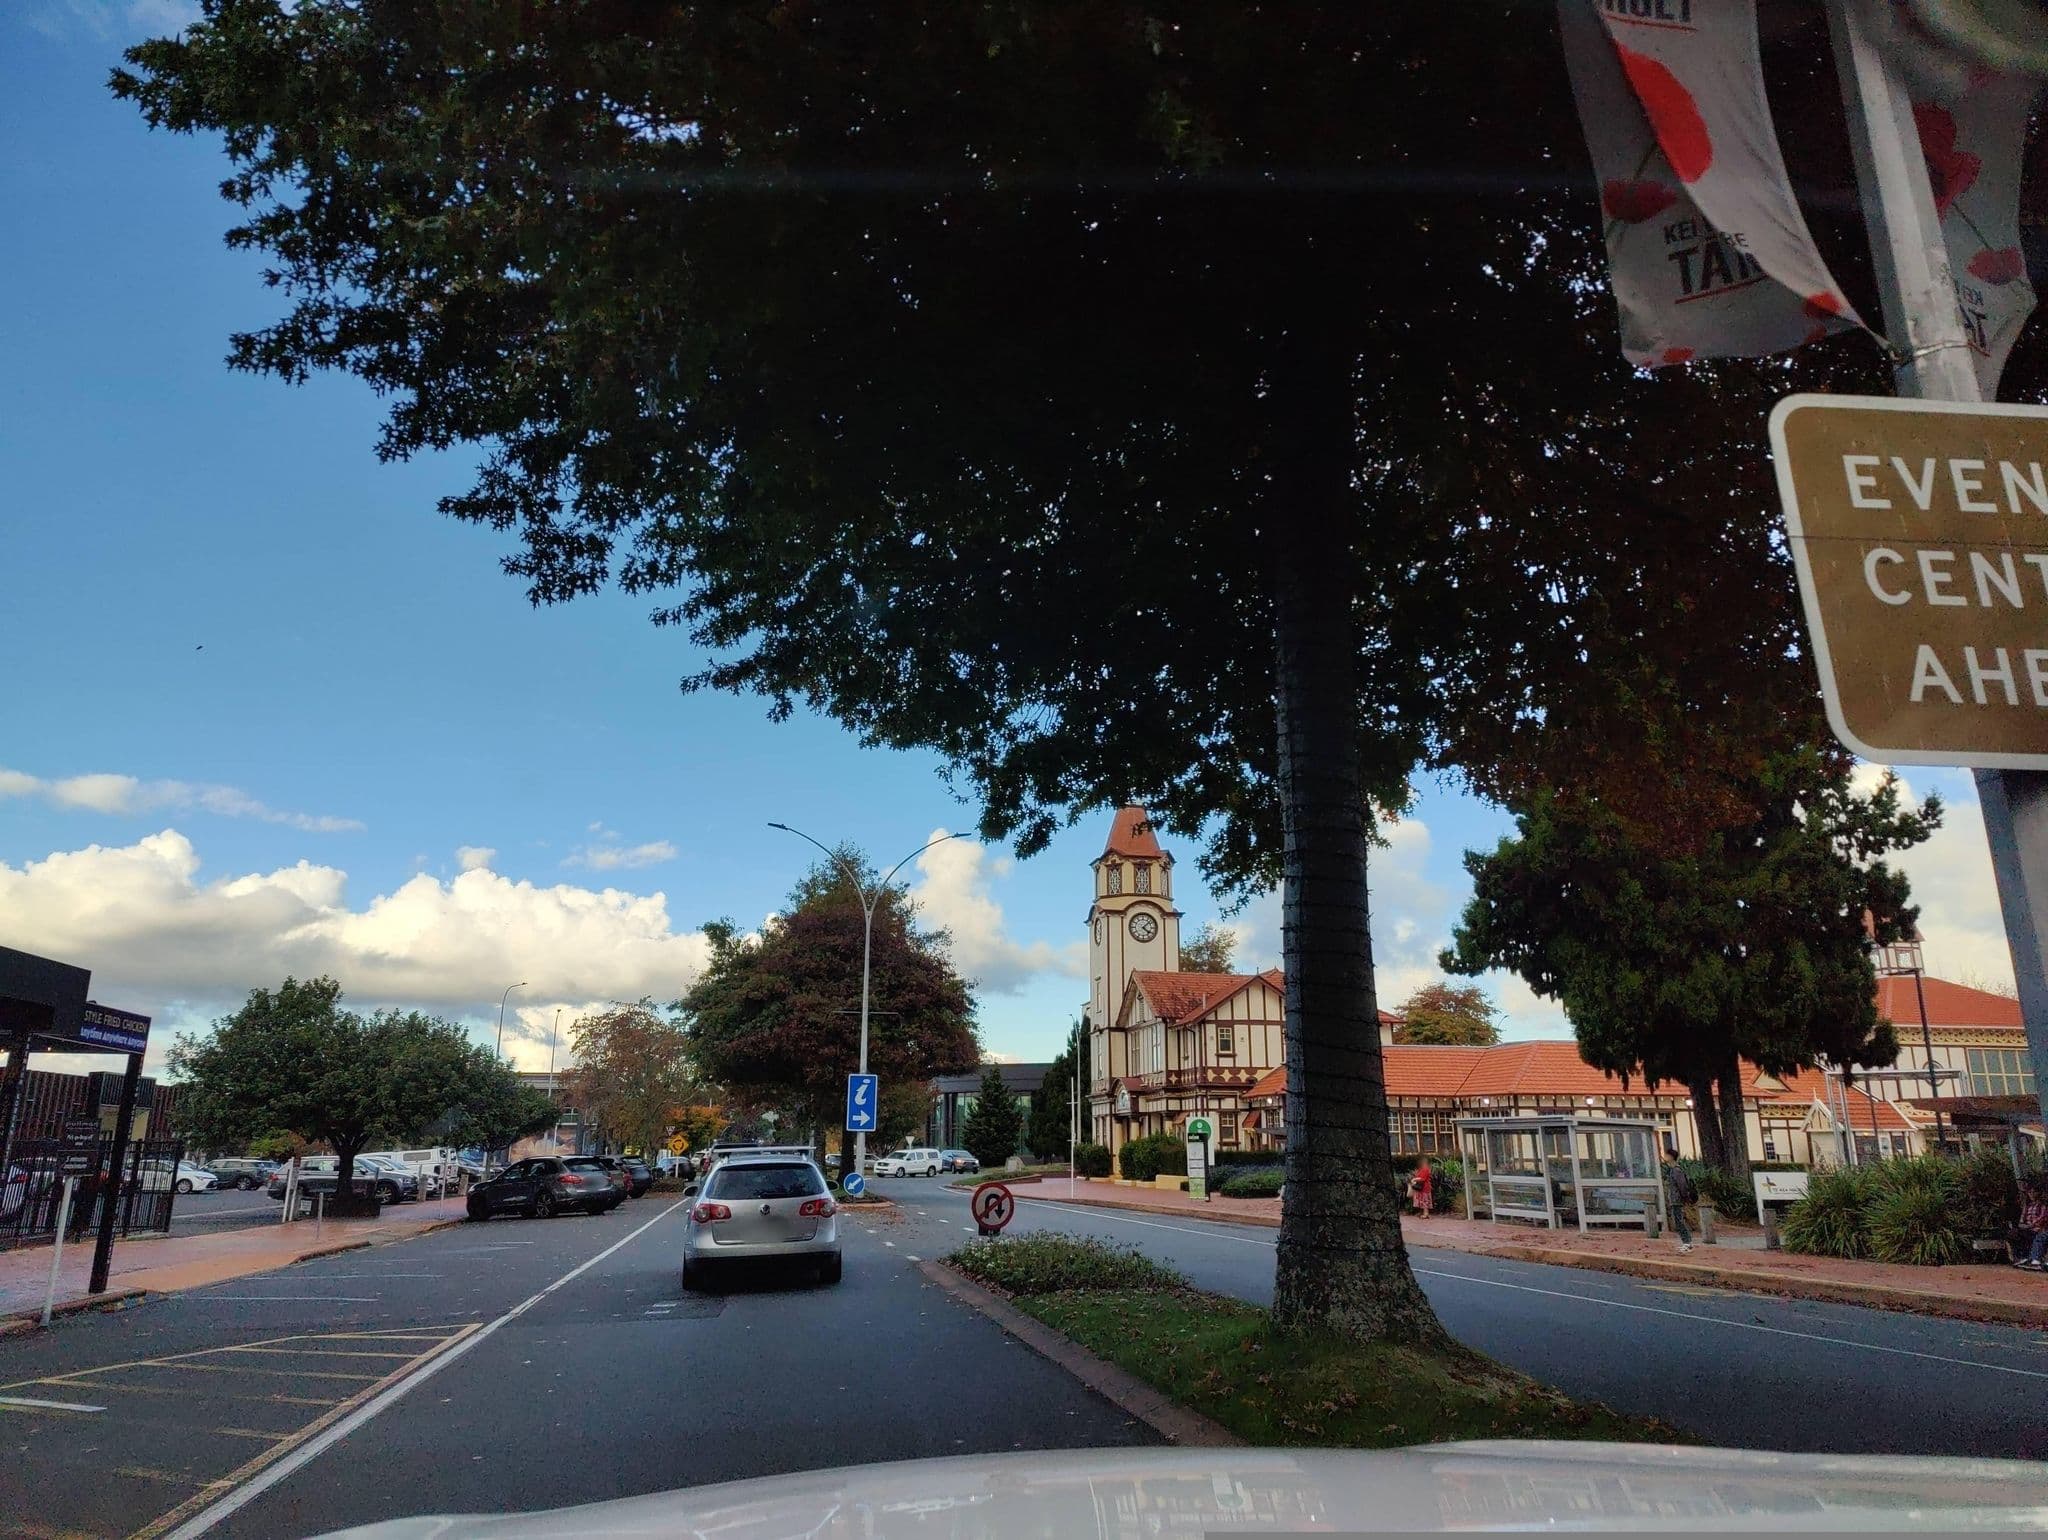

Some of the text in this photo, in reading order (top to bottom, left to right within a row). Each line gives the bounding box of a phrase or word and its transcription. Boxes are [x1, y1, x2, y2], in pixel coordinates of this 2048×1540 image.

[1842, 455, 2048, 515] EVEN
[1864, 548, 2048, 609] CENT
[1908, 644, 2048, 707] AHE
[84, 1010, 147, 1033] STYLE FRIED CHICKEN
